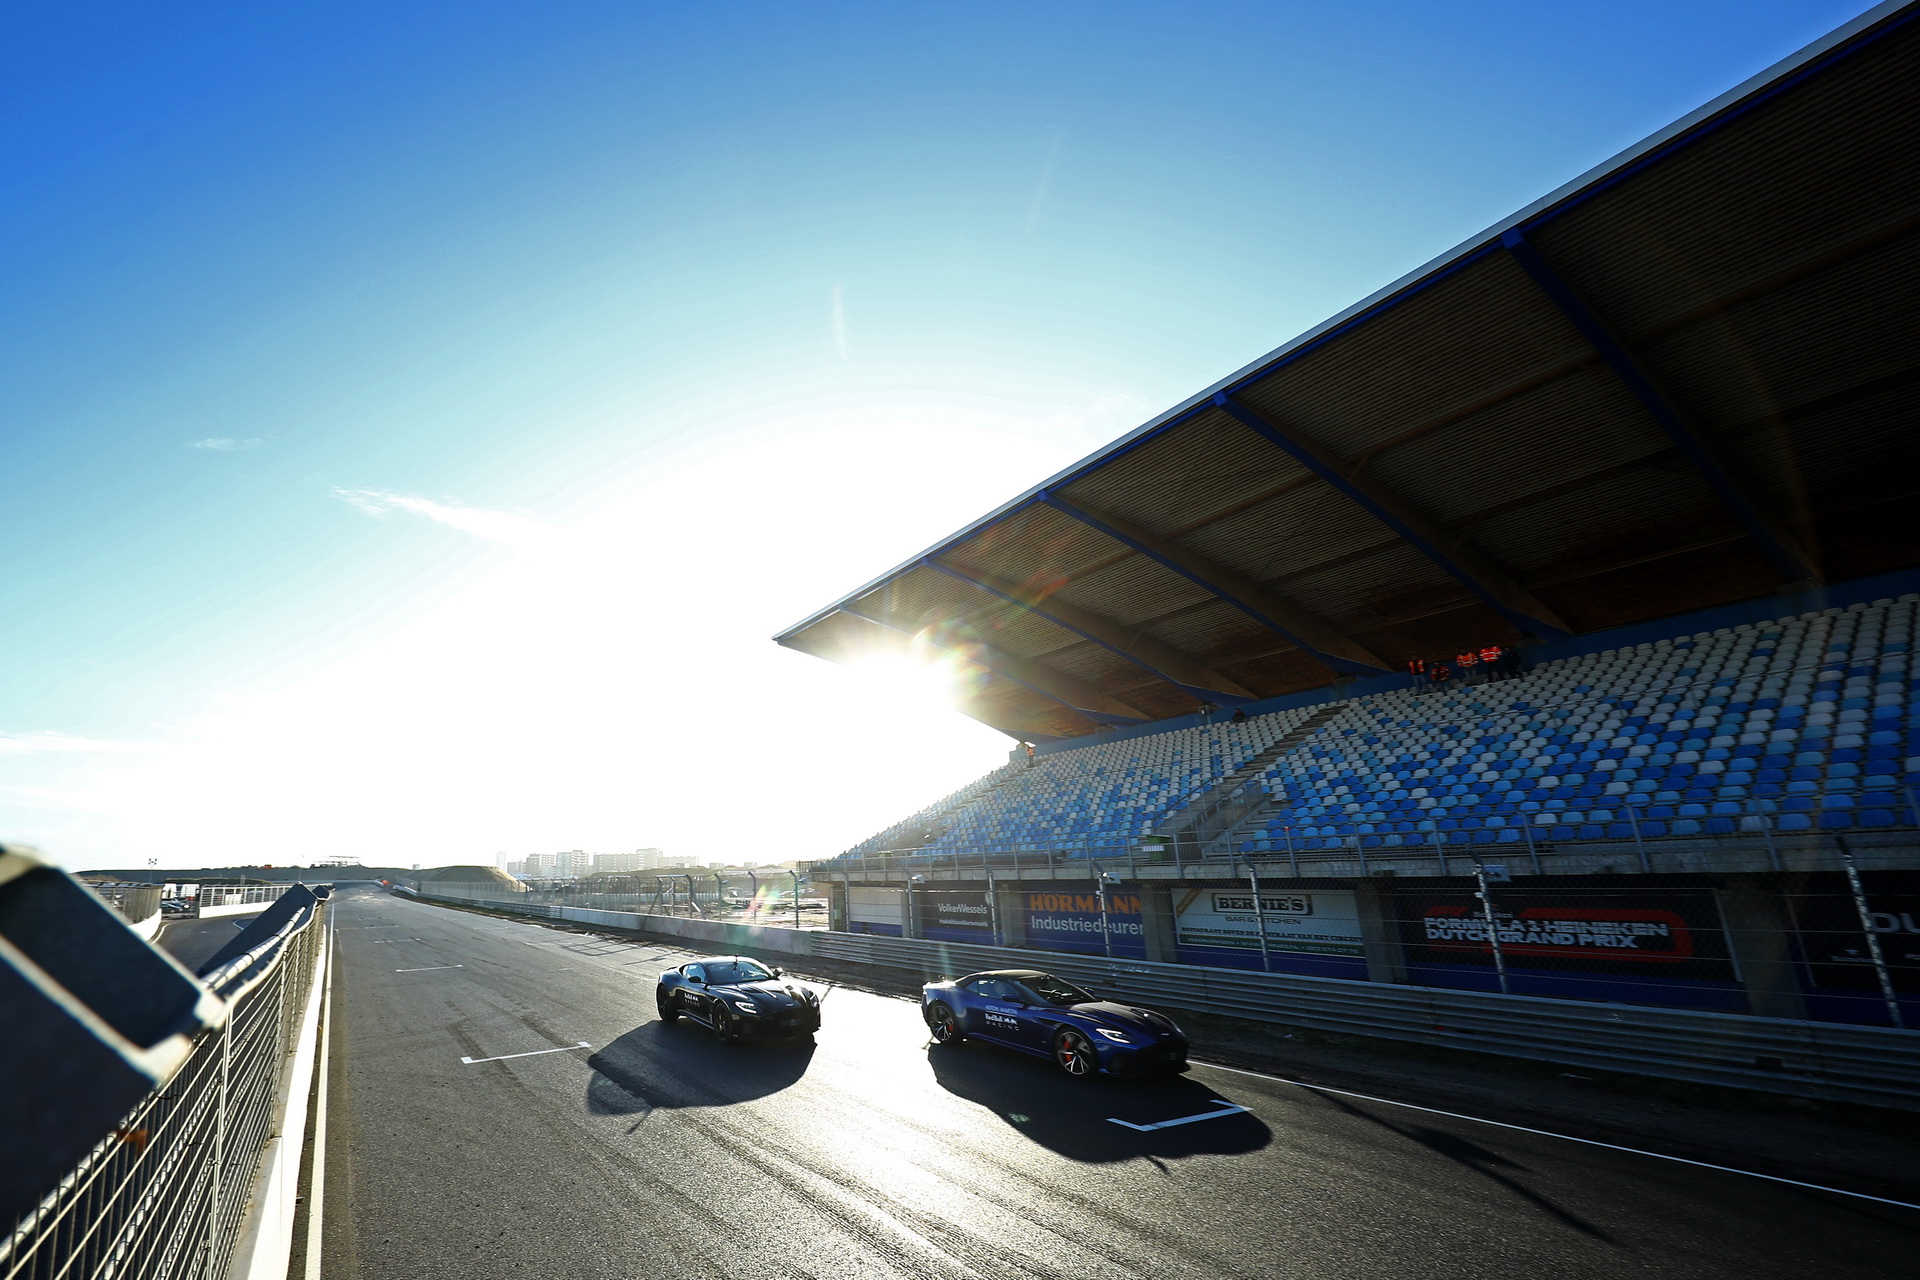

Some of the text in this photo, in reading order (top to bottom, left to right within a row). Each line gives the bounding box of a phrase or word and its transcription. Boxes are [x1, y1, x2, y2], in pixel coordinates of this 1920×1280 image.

[937, 903, 988, 914] VolkerWessels
[1542, 920, 1669, 936] HEINEKEN
[1425, 929, 1639, 949] DUTCH GRAND PRIX
[985, 1020, 1020, 1032] RACING
